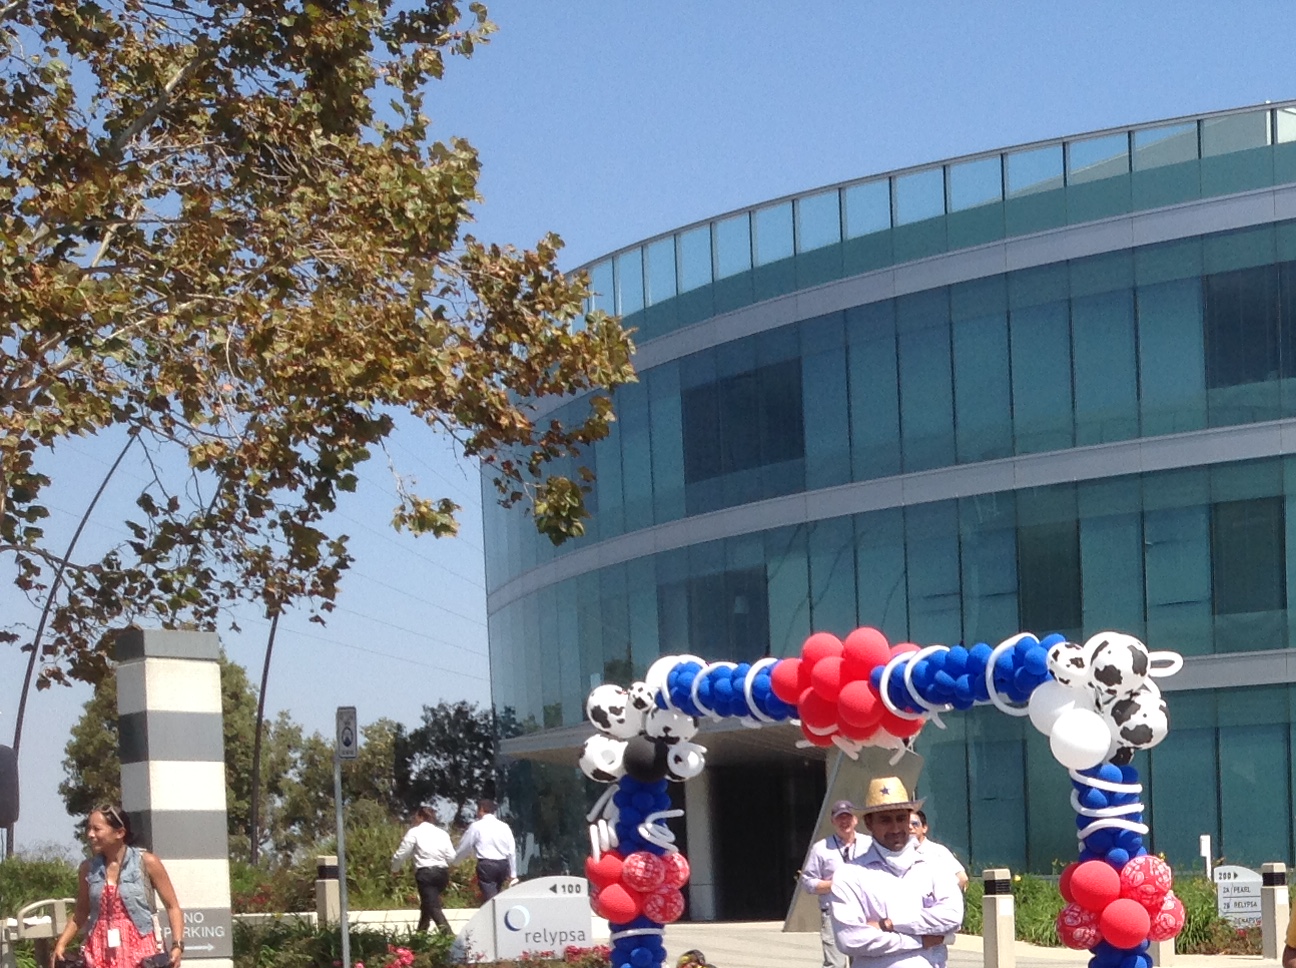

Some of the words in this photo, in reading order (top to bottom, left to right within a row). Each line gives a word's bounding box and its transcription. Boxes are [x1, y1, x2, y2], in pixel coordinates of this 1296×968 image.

[1218, 872, 1231, 880] 200
[561, 884, 581, 894] 100
[184, 912, 204, 923] NO
[164, 926, 224, 938] PRKING
[525, 928, 586, 946] relypsa
